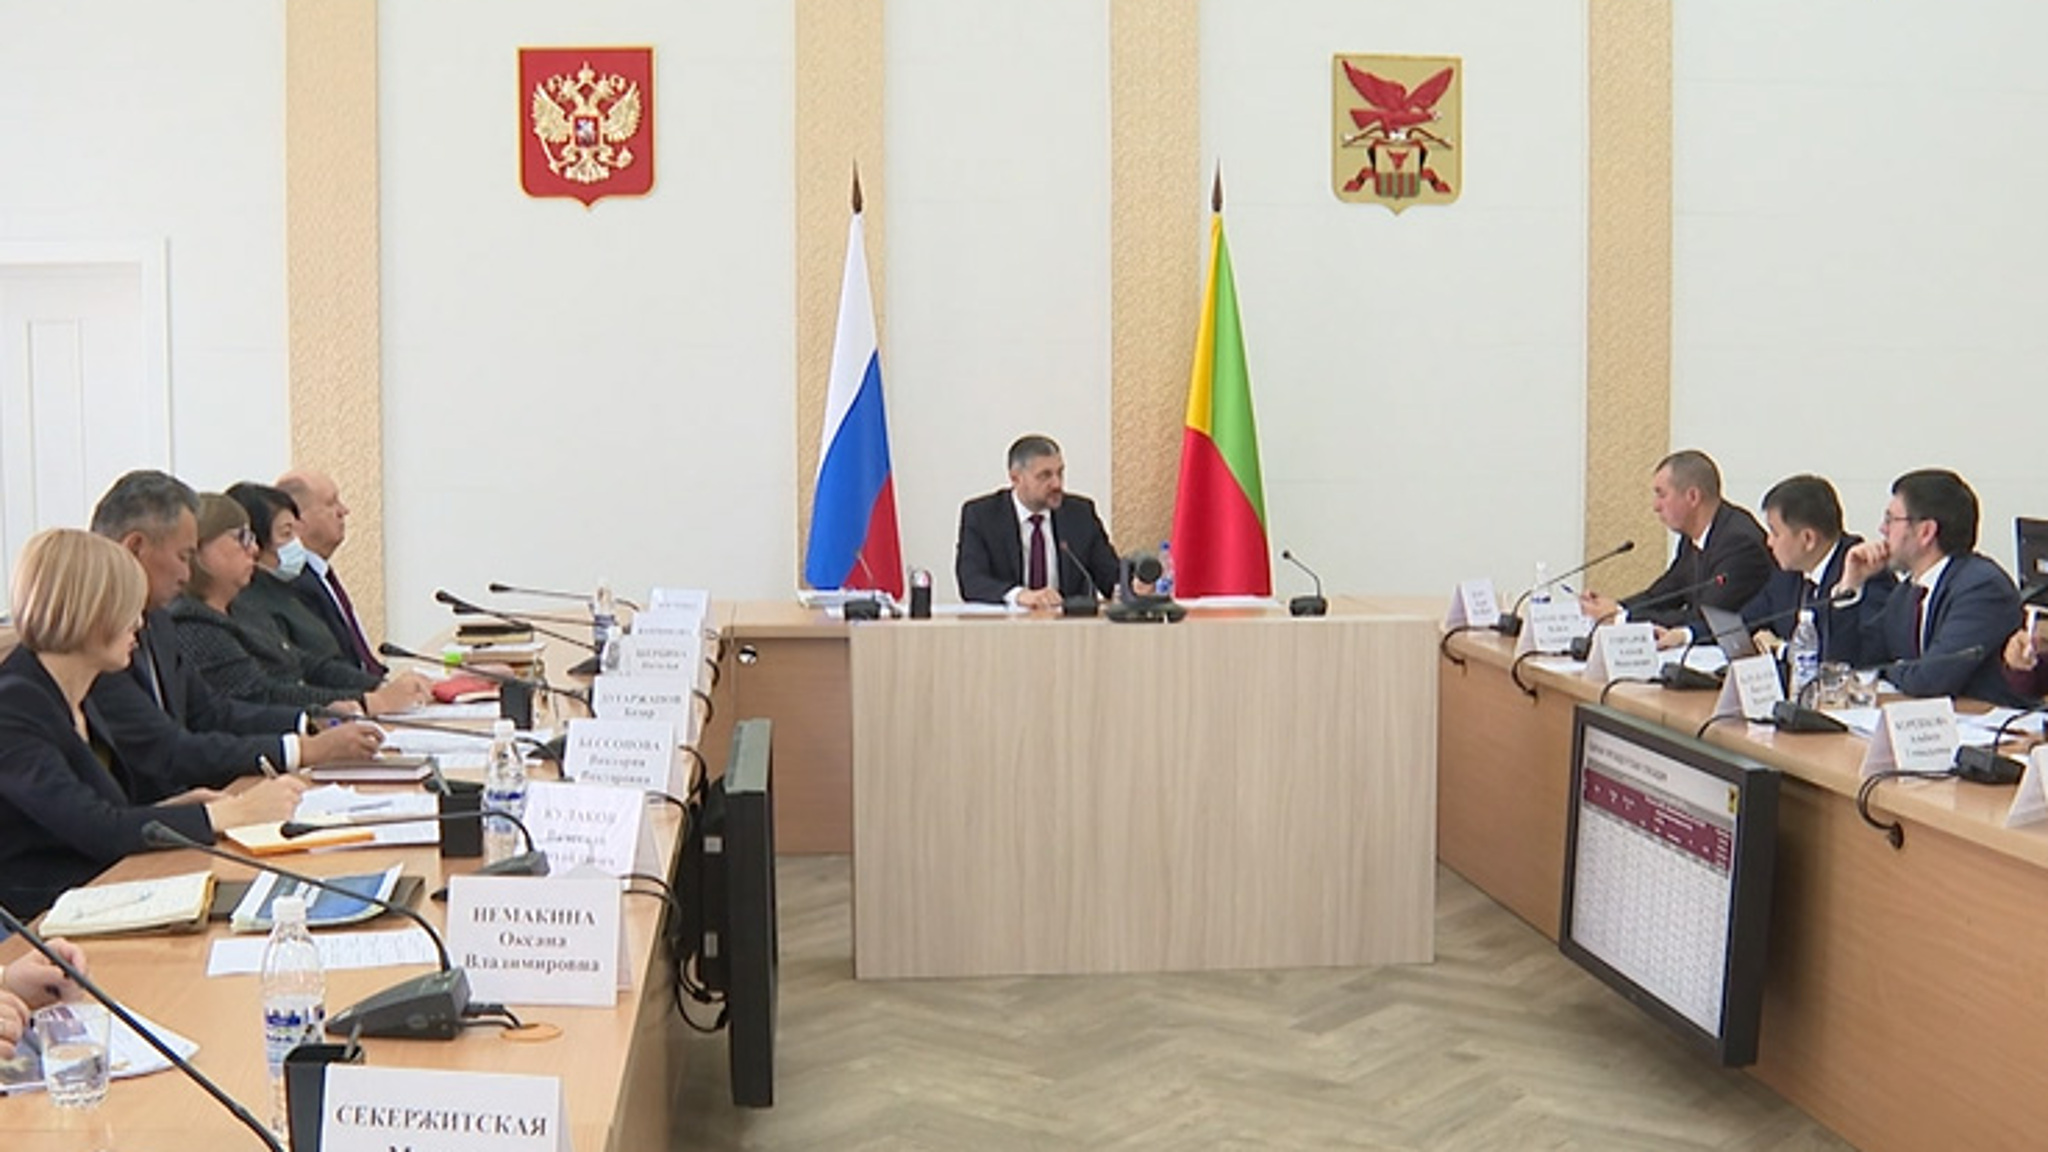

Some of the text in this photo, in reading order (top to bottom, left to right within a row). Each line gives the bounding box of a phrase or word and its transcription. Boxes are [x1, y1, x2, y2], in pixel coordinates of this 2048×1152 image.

[579, 738, 660, 750] БЕССОНОВА
[589, 755, 646, 769] Виктория
[545, 808, 617, 825] КУЛАКОВ
[473, 907, 596, 926] НЕМАКИНА
[499, 931, 567, 947] Оксана
[465, 954, 600, 974] Владимировна
[335, 1104, 547, 1136] СЕКЕРЖИТСКАЯ
